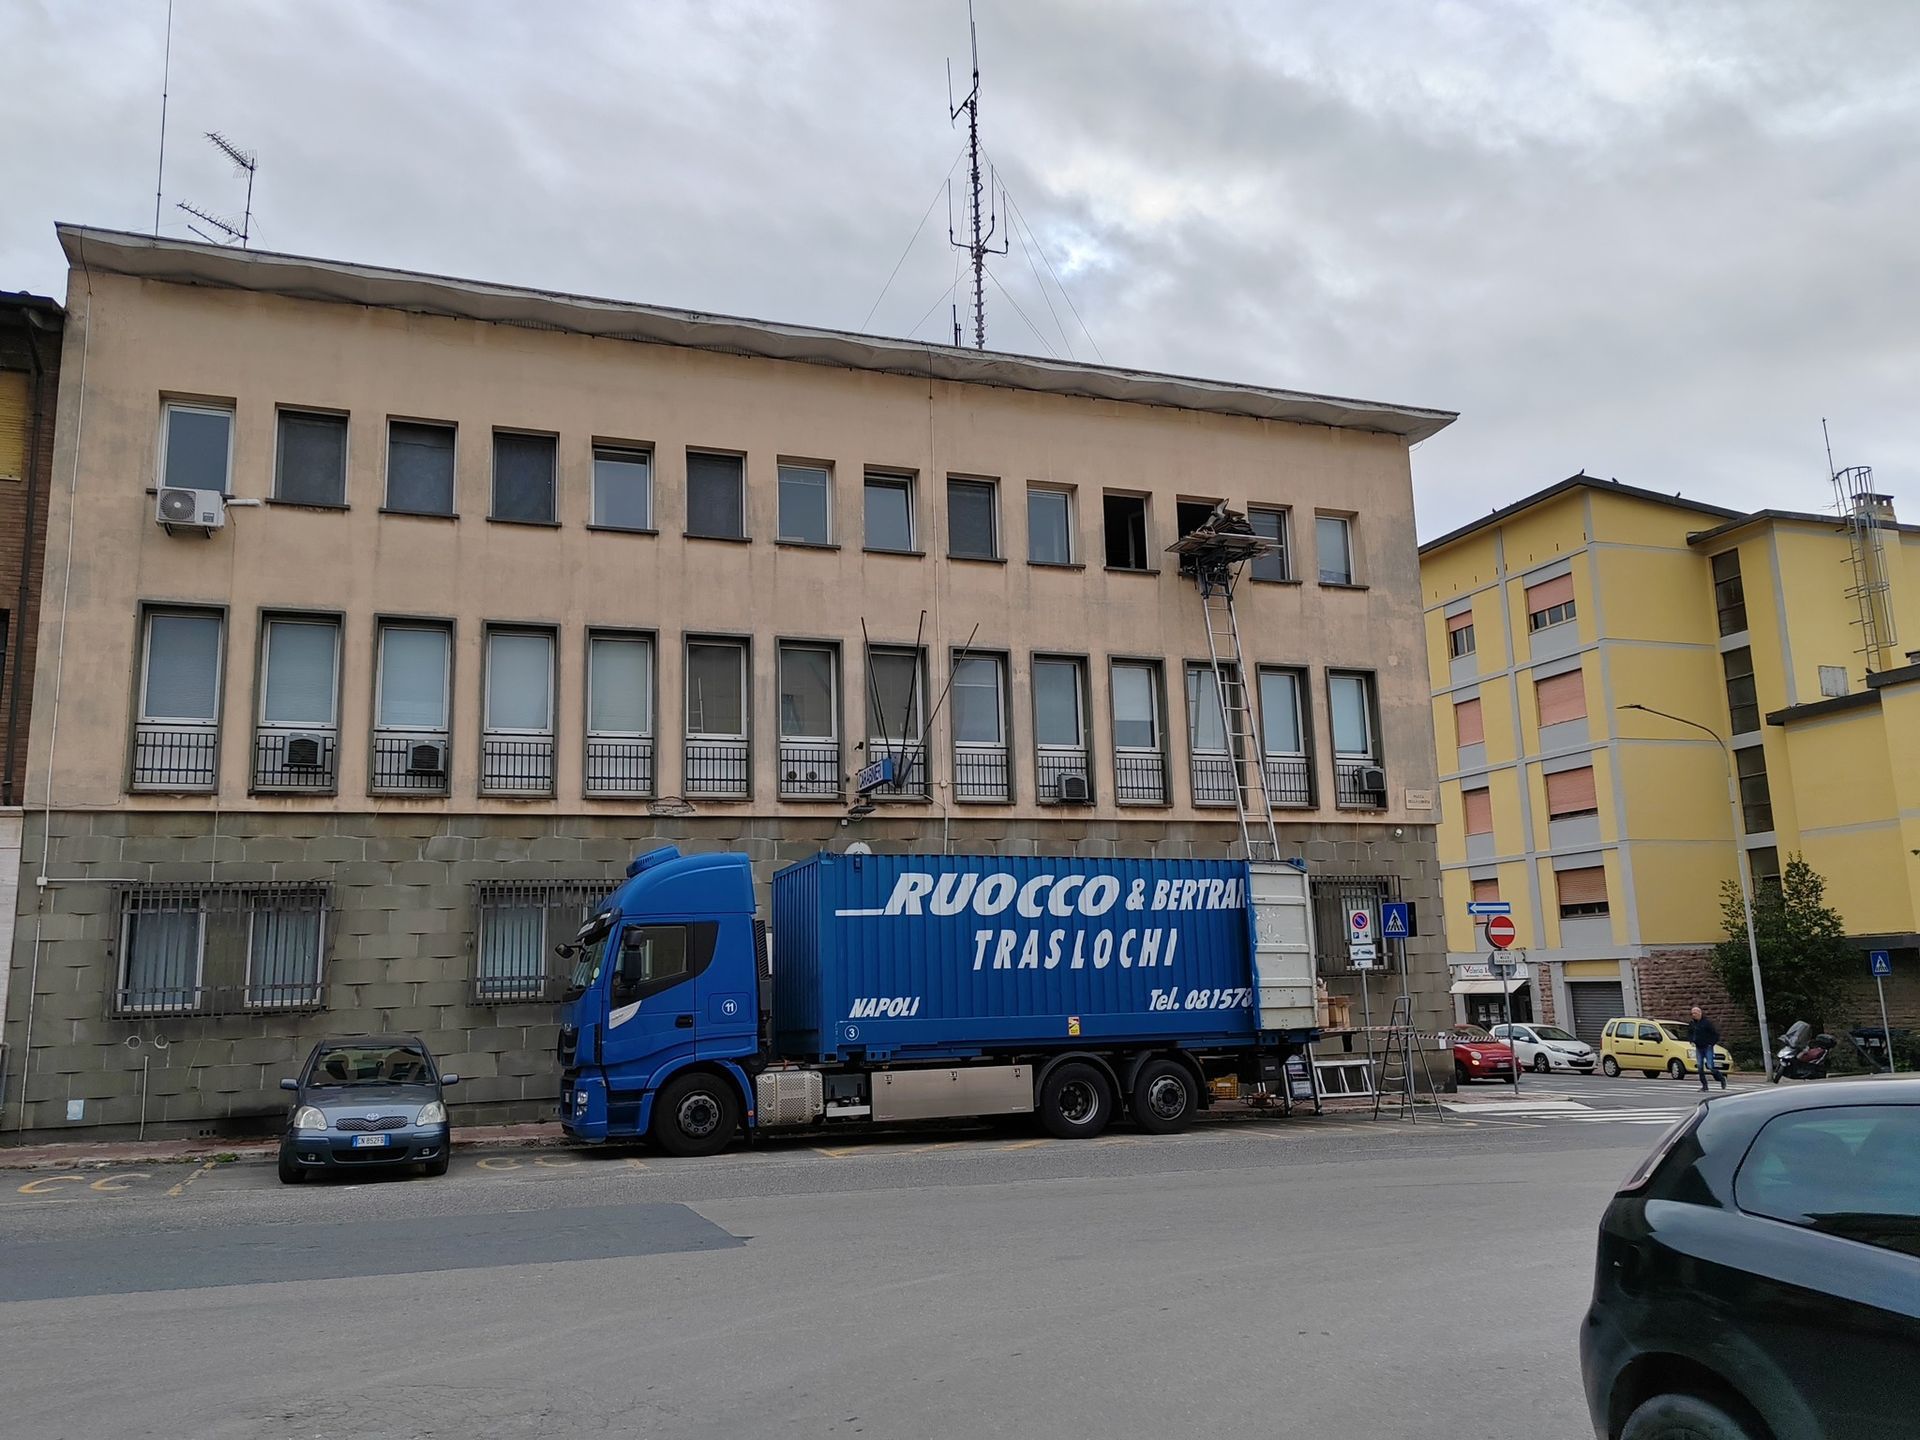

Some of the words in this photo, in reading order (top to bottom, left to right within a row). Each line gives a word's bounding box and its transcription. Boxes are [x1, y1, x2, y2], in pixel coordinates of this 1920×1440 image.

[882, 872, 1120, 918] RUOCCO
[1125, 878, 1146, 911] &
[972, 928, 1178, 971] TRASLOCHI
[848, 996, 921, 1019] NAPOLI
[1149, 987, 1180, 1011] Tel.
[1184, 988, 1254, 1010] 081578
